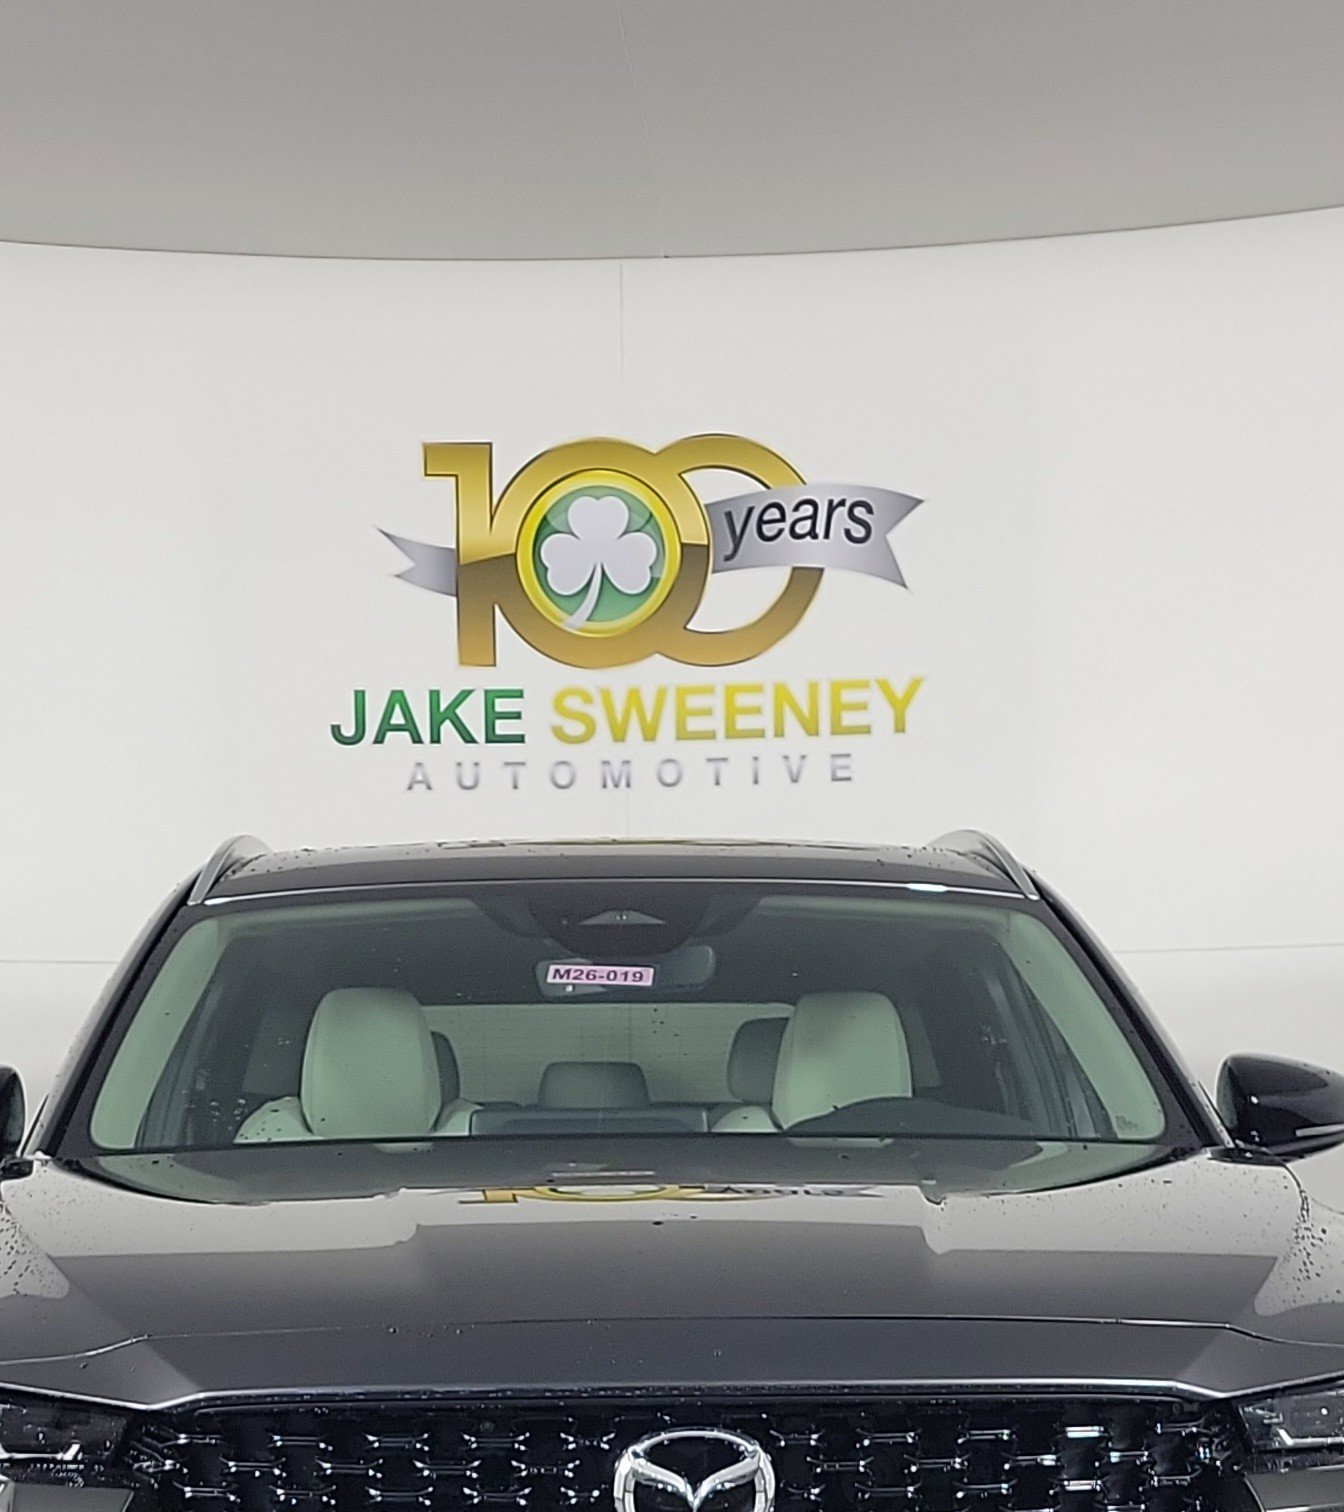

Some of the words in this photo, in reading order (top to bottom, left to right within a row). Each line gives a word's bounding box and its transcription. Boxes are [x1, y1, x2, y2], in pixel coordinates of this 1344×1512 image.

[722, 497, 875, 562] years
[330, 689, 526, 746] JAKE
[551, 677, 925, 746] SWEENEY
[406, 753, 854, 791] AUTOMOTIVE
[552, 968, 644, 983] M26-019
